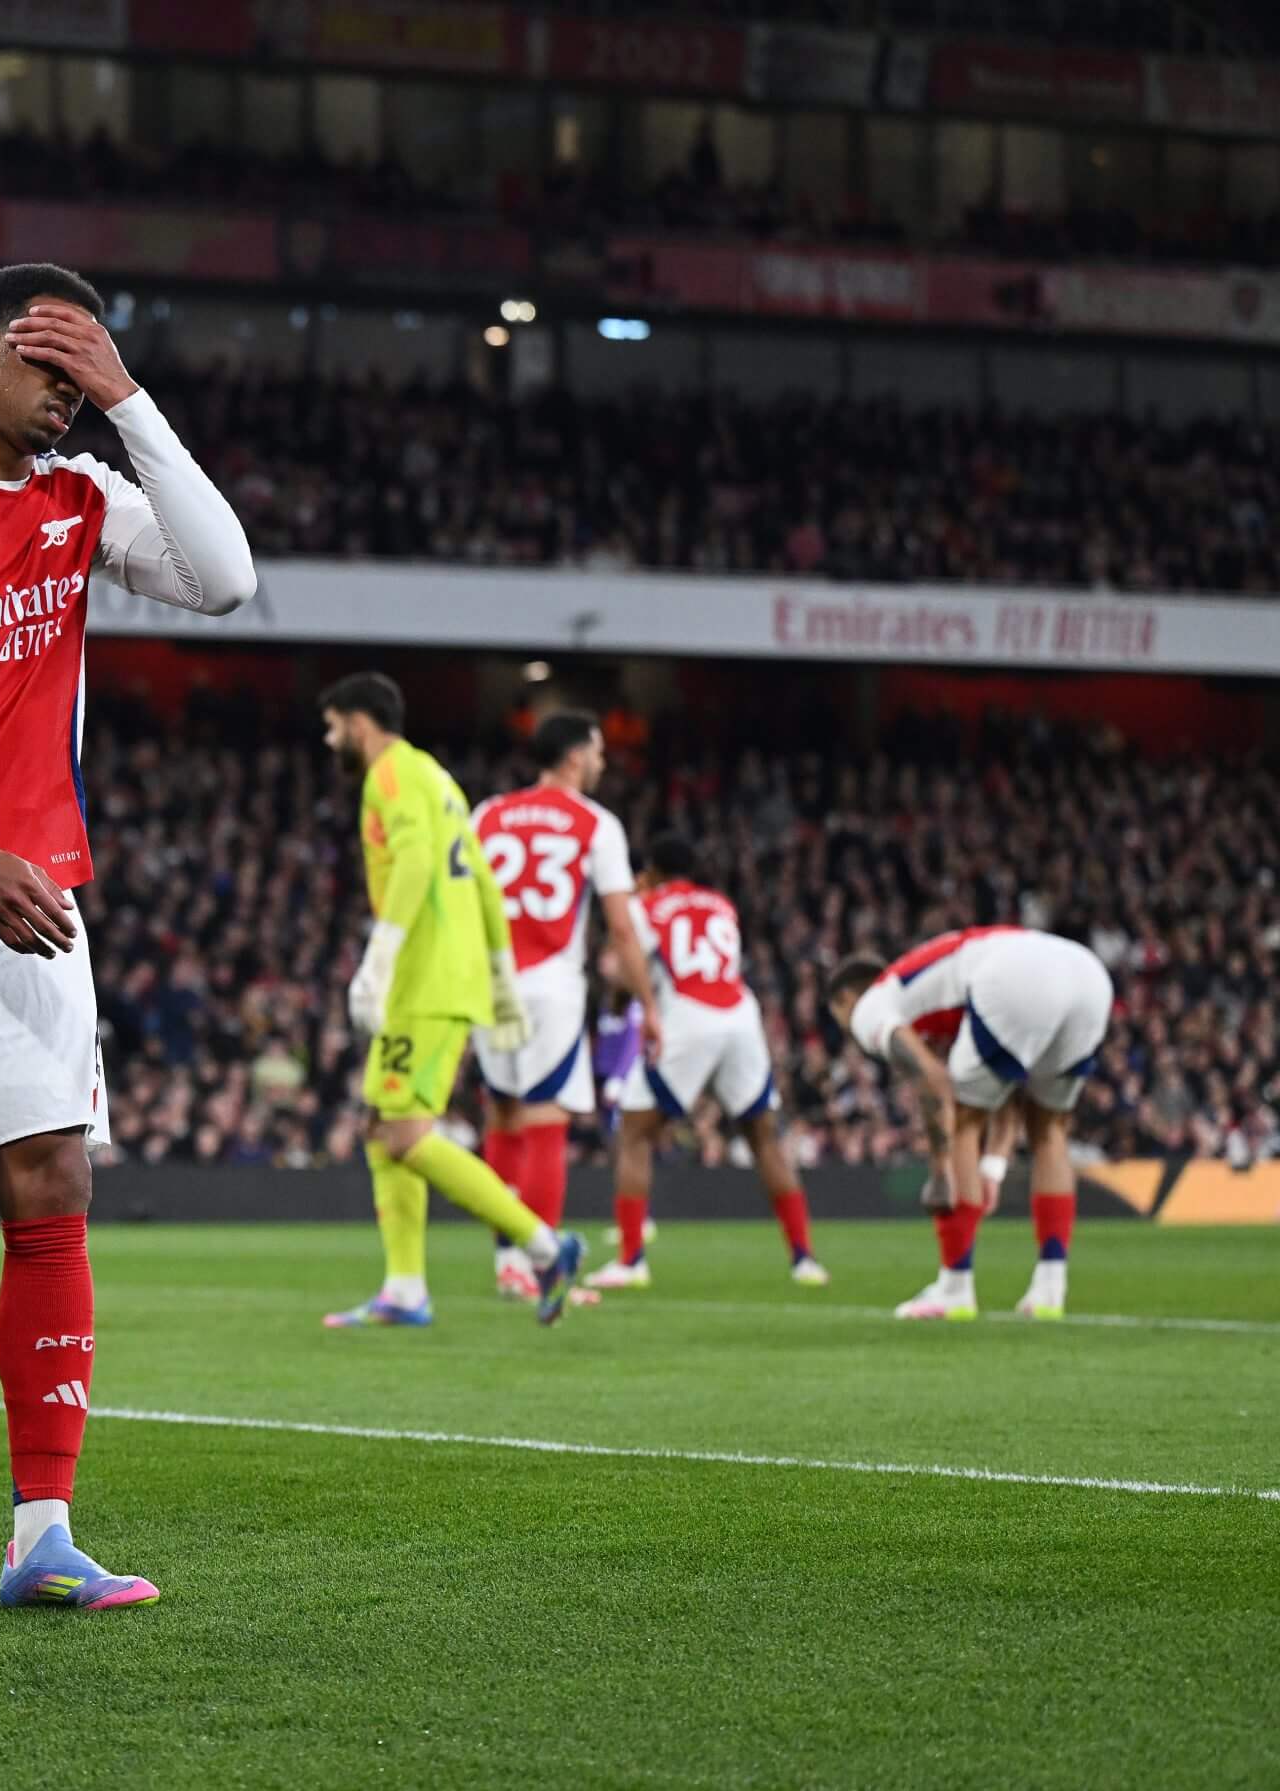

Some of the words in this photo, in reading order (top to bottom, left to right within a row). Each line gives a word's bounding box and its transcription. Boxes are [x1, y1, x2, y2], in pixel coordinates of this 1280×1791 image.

[772, 596, 977, 649] Emirates
[483, 832, 581, 923] 23
[671, 914, 740, 983] 49
[35, 1335, 94, 1352] AFC
